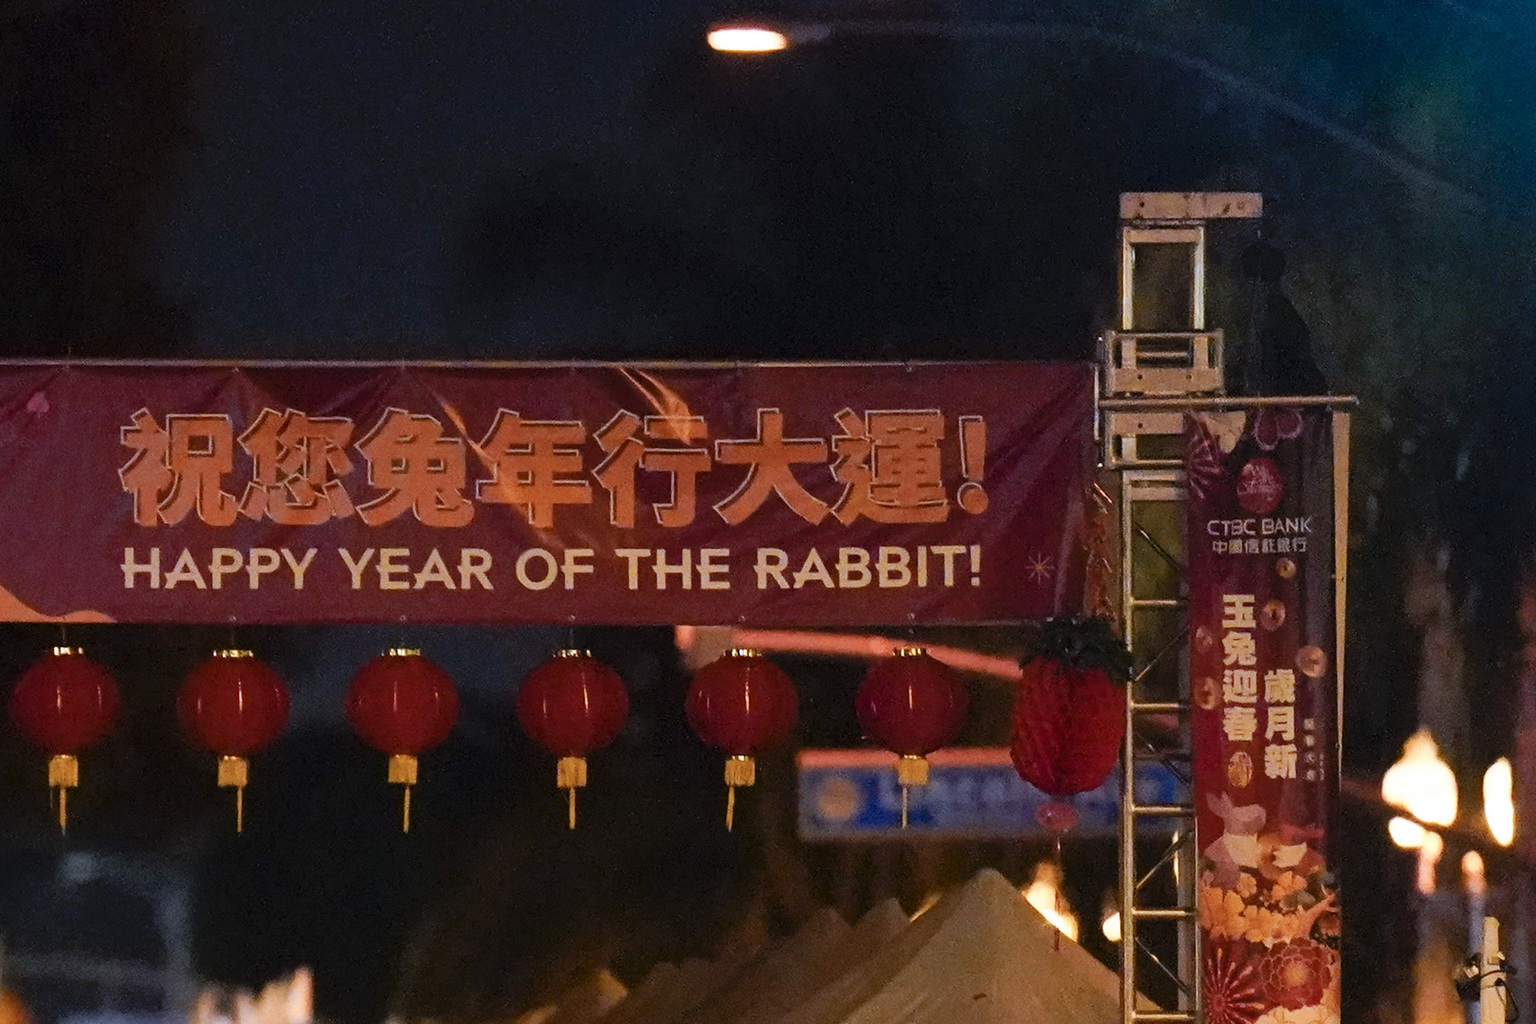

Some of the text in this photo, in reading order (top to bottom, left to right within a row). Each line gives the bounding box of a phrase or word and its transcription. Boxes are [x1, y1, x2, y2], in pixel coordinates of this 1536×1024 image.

[118, 407, 989, 528] 祝您兔年行大運!
[121, 544, 982, 591] HAPPY YEAR OF THE RABBIT!
[1207, 516, 1312, 536] CTBC BANK
[1221, 594, 1258, 742] 玉兔迎春
